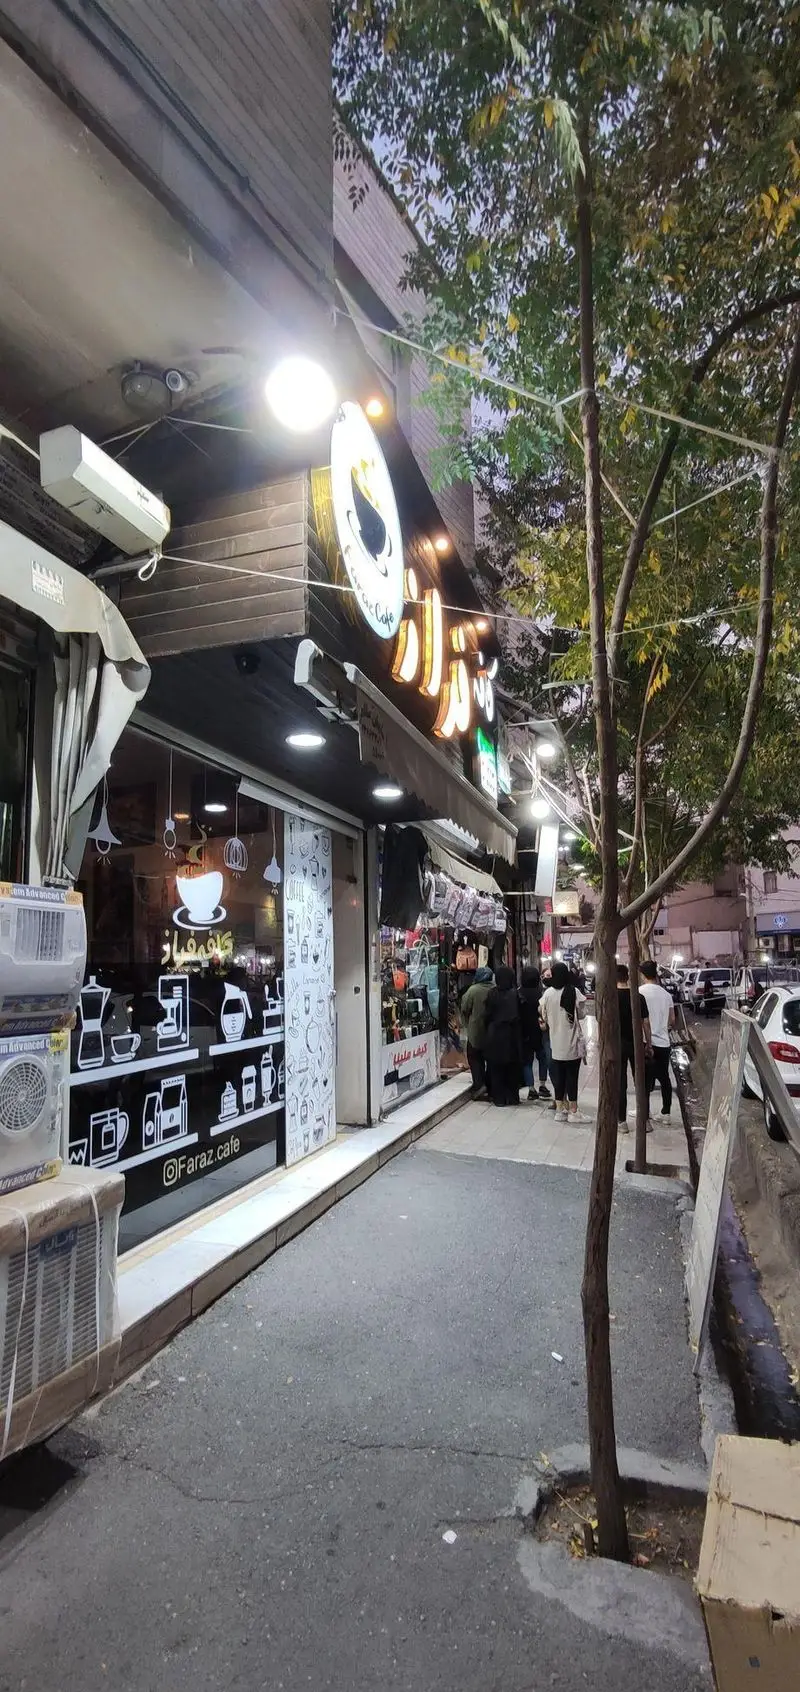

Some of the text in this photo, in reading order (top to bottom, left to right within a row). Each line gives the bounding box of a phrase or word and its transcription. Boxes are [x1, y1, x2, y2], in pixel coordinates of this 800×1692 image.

[375, 602, 394, 632] Cafe
[392, 566, 471, 738] فراز
[25, 888, 60, 901] Advanced
[197, 929, 233, 960] کافه
[8, 1037, 46, 1053] Advanced
[178, 1134, 241, 1179] Faraz.cafe
